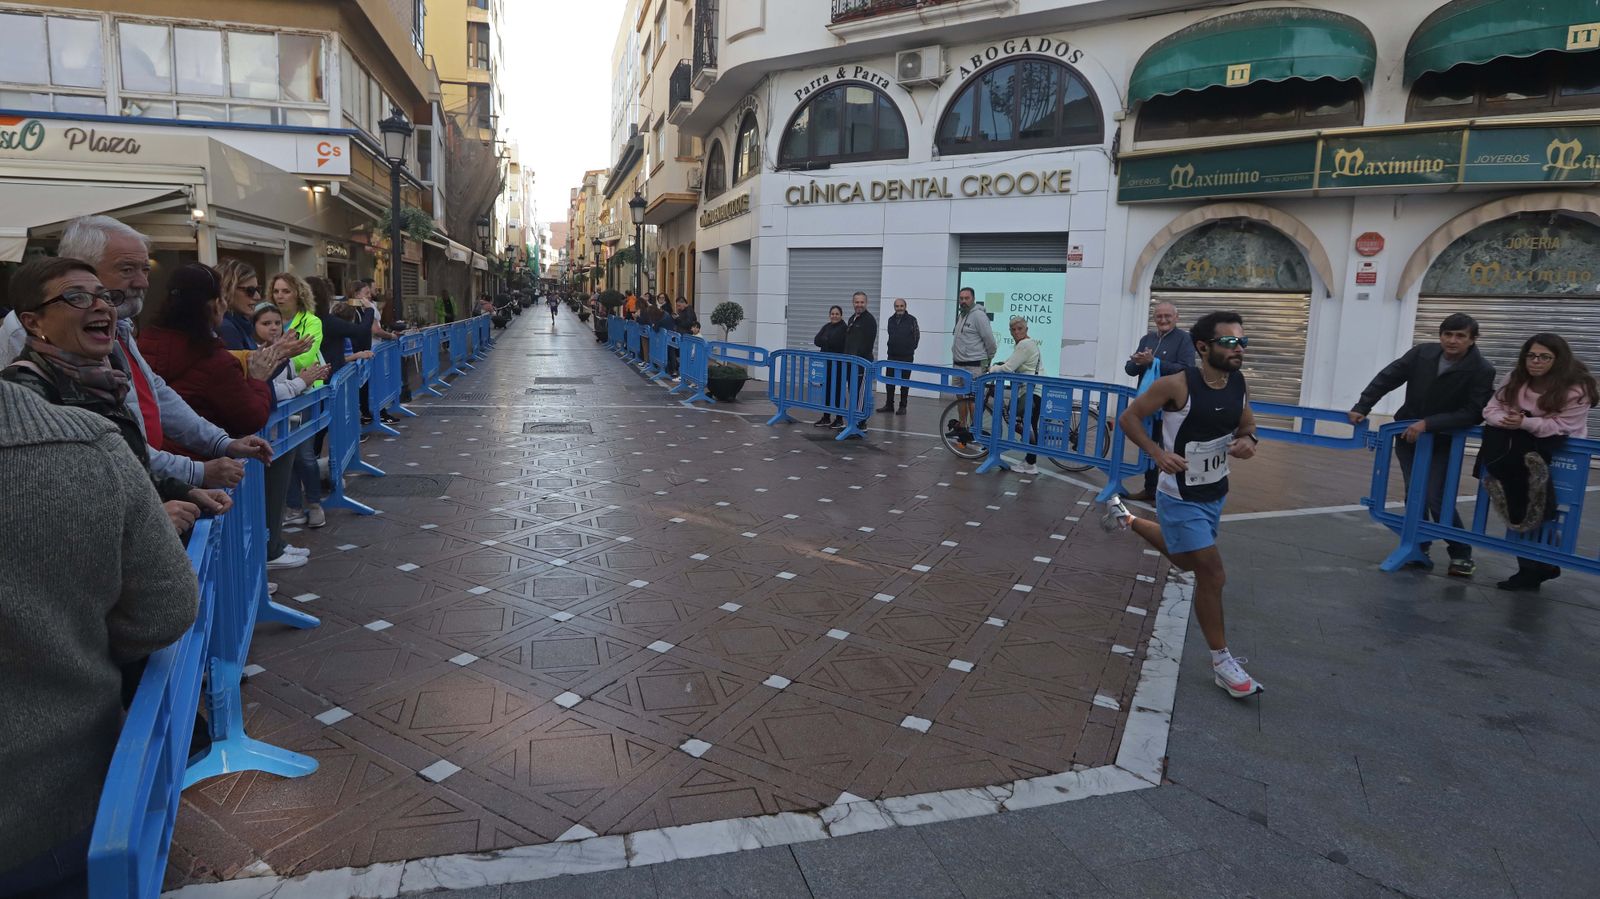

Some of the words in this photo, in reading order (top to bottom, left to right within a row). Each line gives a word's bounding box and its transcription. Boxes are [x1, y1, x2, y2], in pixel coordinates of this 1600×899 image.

[960, 38, 1084, 80] ABOGADOS
[794, 74, 829, 102] Parra
[836, 66, 846, 80] &
[854, 66, 890, 90] Parra
[64, 127, 141, 154] Plaza
[317, 142, 341, 157] Cs
[1331, 147, 1445, 179] Maximino
[1474, 153, 1530, 164] JOYEROS
[1541, 138, 1600, 171] Ma
[785, 179, 865, 206] CLÍNICA
[870, 176, 953, 201] DENTAL
[960, 169, 1073, 196] CROOKE
[1128, 176, 1161, 187] OYEROS
[1168, 163, 1260, 191] Maximino
[1505, 237, 1561, 250] JOYERIA
[1471, 261, 1592, 286] Maximino
[1010, 303, 1053, 313] DENTAL
[1011, 293, 1054, 303] CROOKE
[1009, 314, 1052, 325] CNICS
